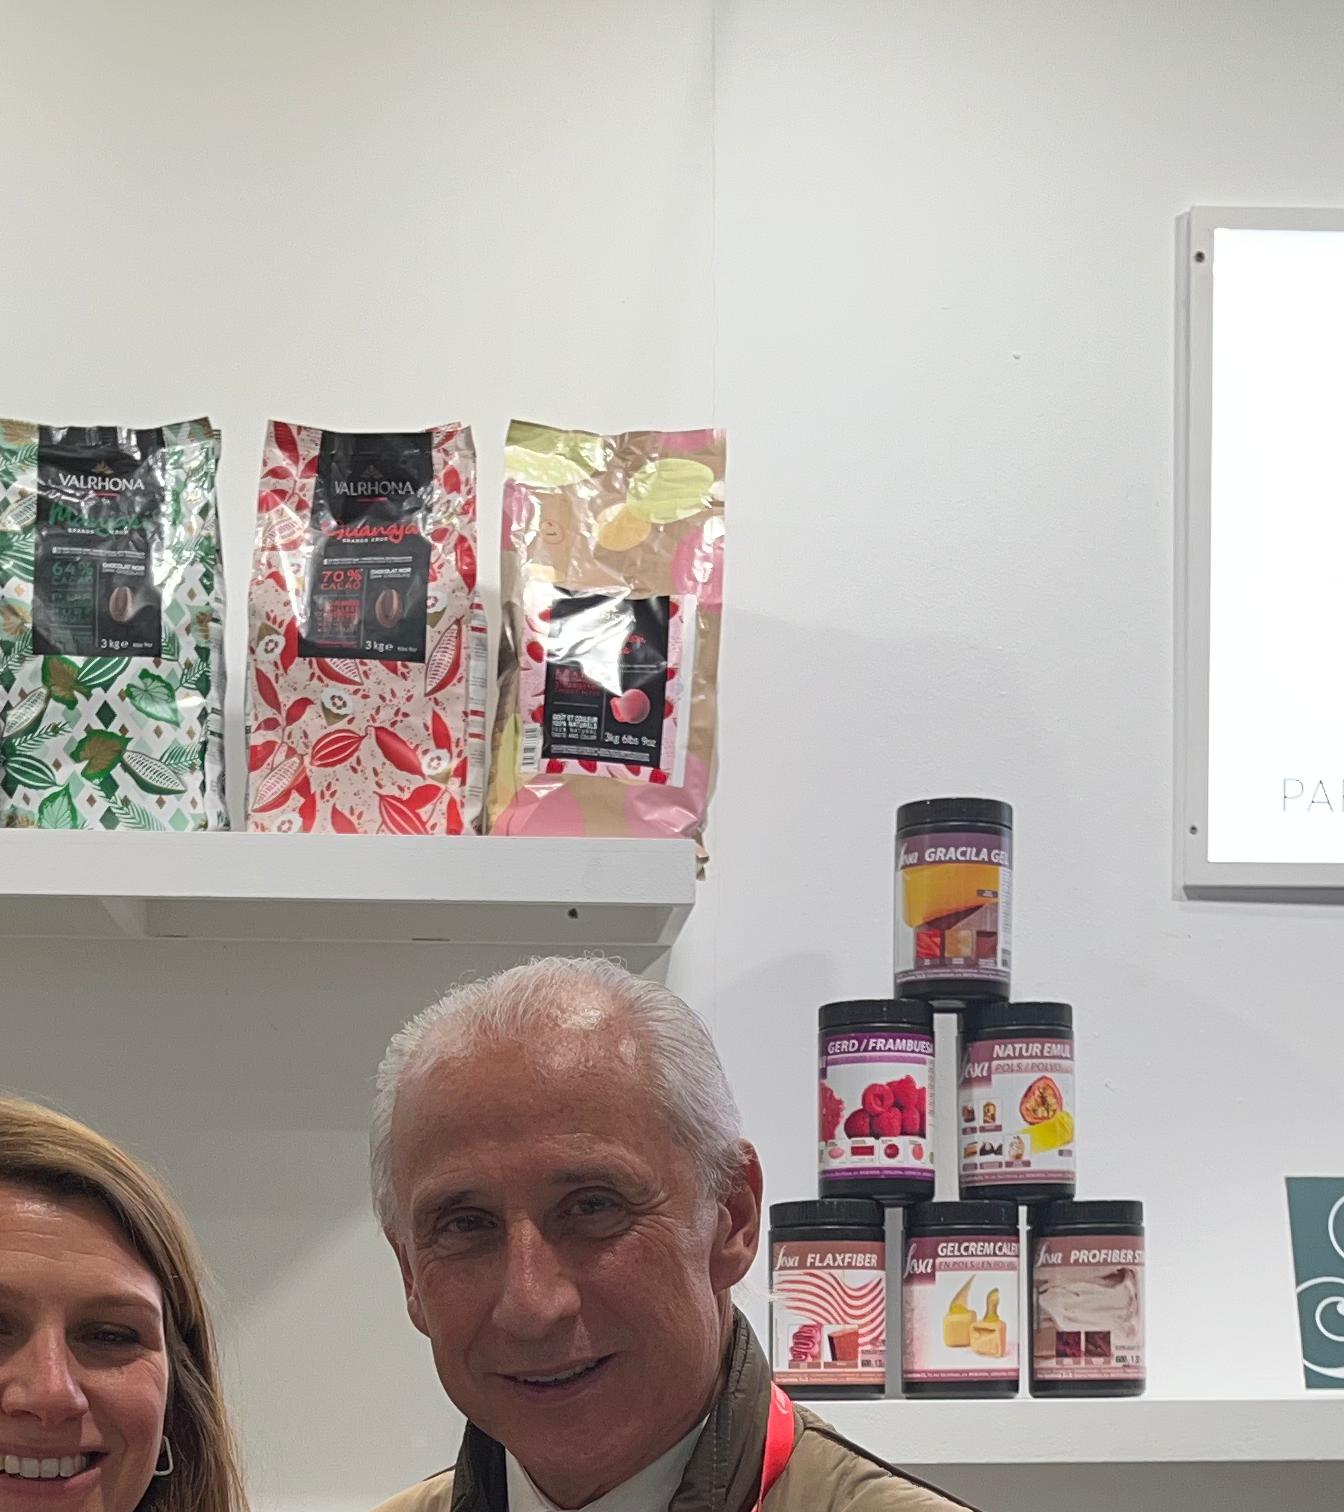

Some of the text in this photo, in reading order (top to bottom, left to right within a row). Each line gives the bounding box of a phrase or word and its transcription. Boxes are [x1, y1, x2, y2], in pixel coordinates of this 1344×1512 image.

[58, 473, 145, 491] VALRHONA
[334, 480, 415, 496] VALRHONA
[924, 846, 1009, 865] GRACILA GEL
[827, 1041, 859, 1054] GERD
[993, 1043, 1041, 1058] NATUR
[995, 1062, 1024, 1073] POLS
[937, 1241, 993, 1257] GELCREM
[1070, 1249, 1133, 1265] PROFIBER
[806, 1252, 878, 1267] FLAXFIBER
[903, 1243, 934, 1279] Sosa
